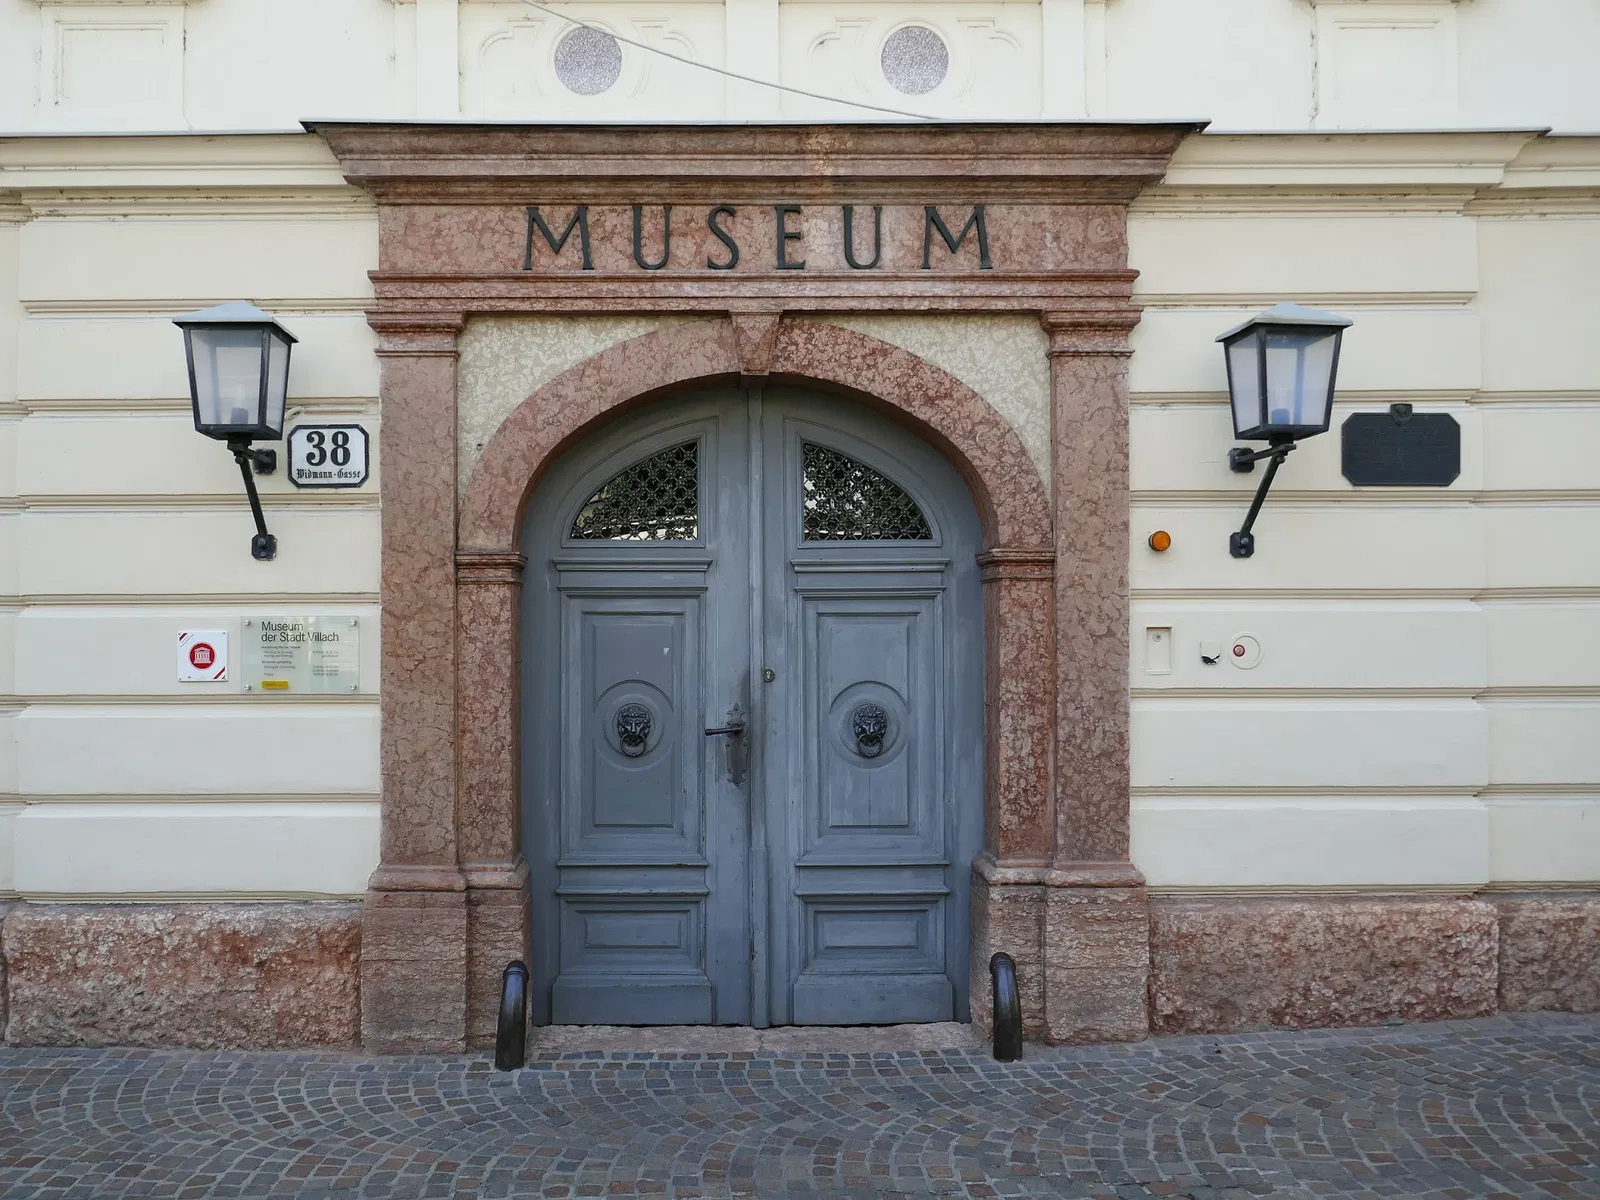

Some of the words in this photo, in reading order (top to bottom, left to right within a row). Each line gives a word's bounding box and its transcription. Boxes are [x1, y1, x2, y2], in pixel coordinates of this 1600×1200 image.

[522, 205, 993, 270] MUSEUM
[306, 431, 351, 466] 38
[261, 621, 304, 631] Museum
[261, 632, 277, 642] der
[280, 632, 305, 642] Stadt
[307, 632, 340, 642] Villach
